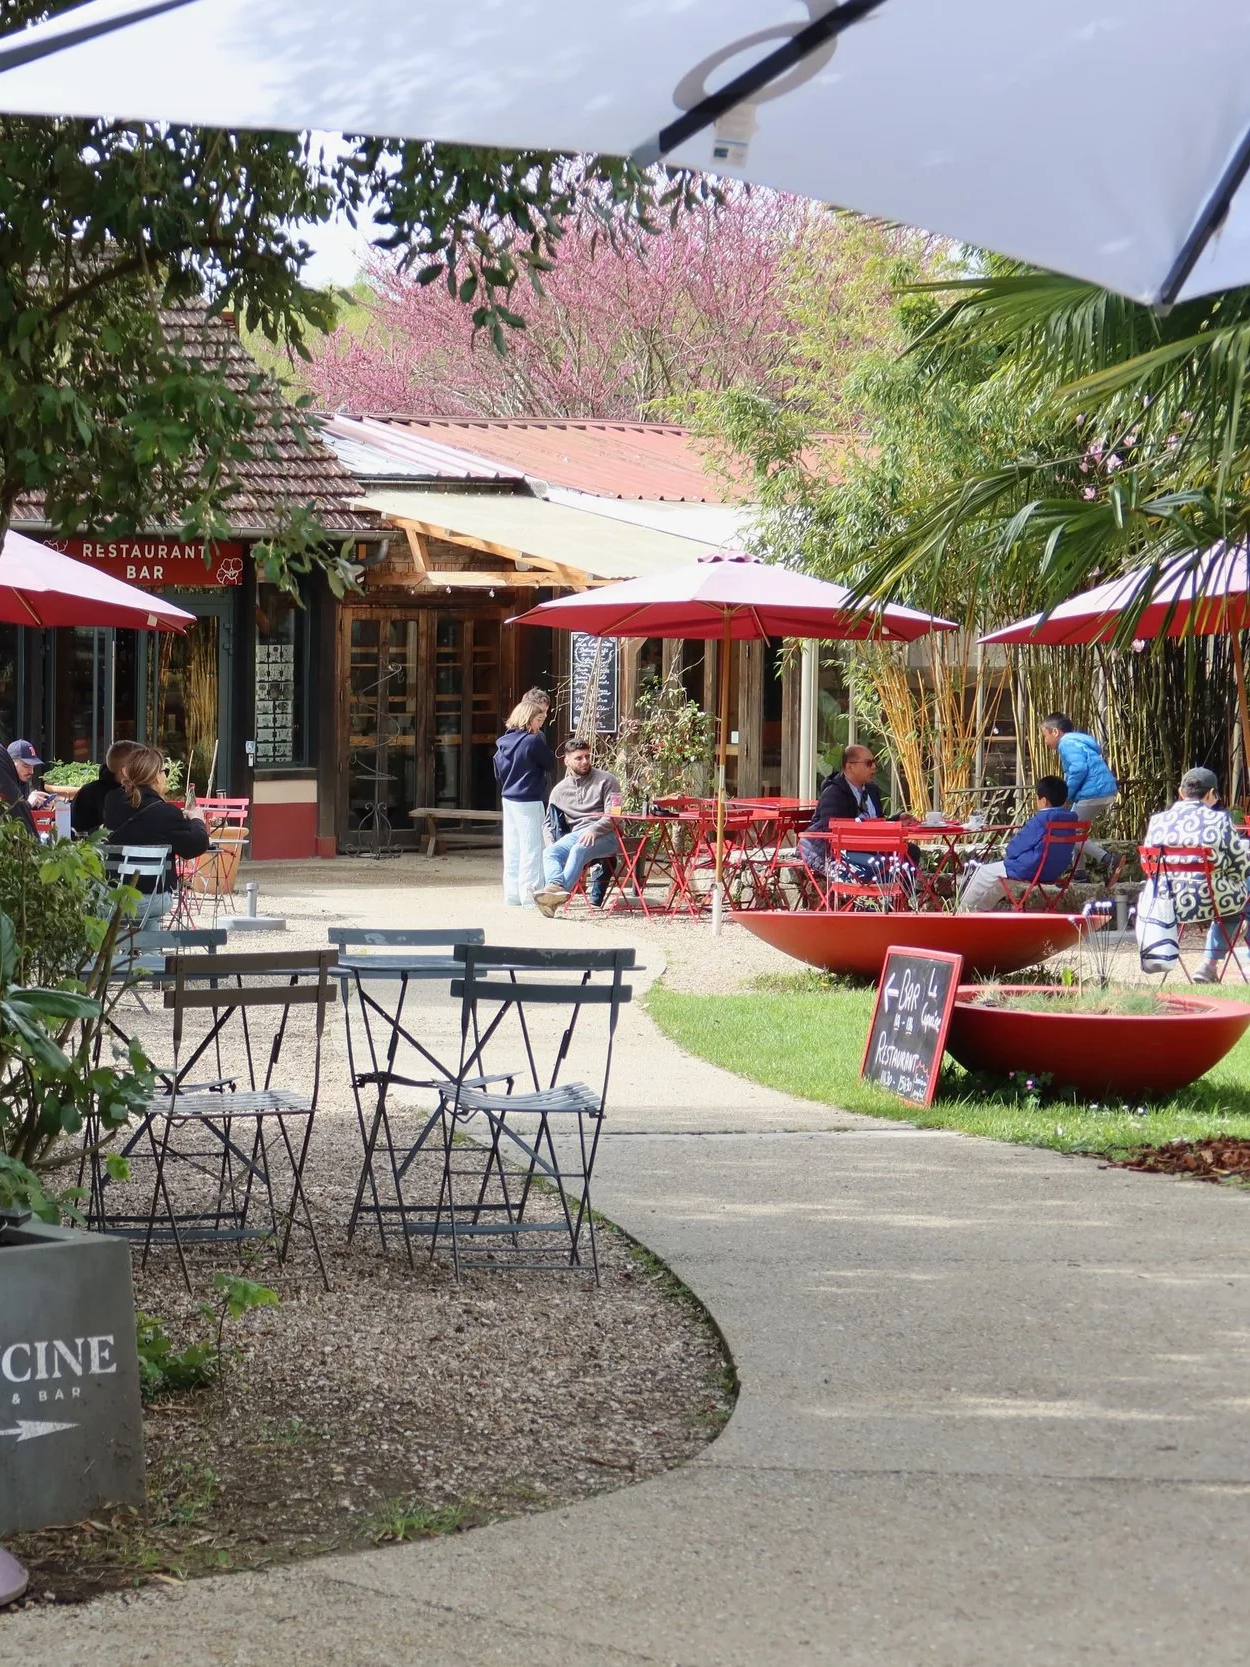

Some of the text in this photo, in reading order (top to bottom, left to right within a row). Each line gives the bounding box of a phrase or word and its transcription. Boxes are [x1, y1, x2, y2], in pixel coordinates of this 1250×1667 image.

[82, 543, 206, 559] RESTAURANT
[126, 565, 164, 579] BAR
[898, 968, 921, 1012] BAR
[11, 1392, 22, 1405] &
[38, 1387, 83, 1402] BAR
